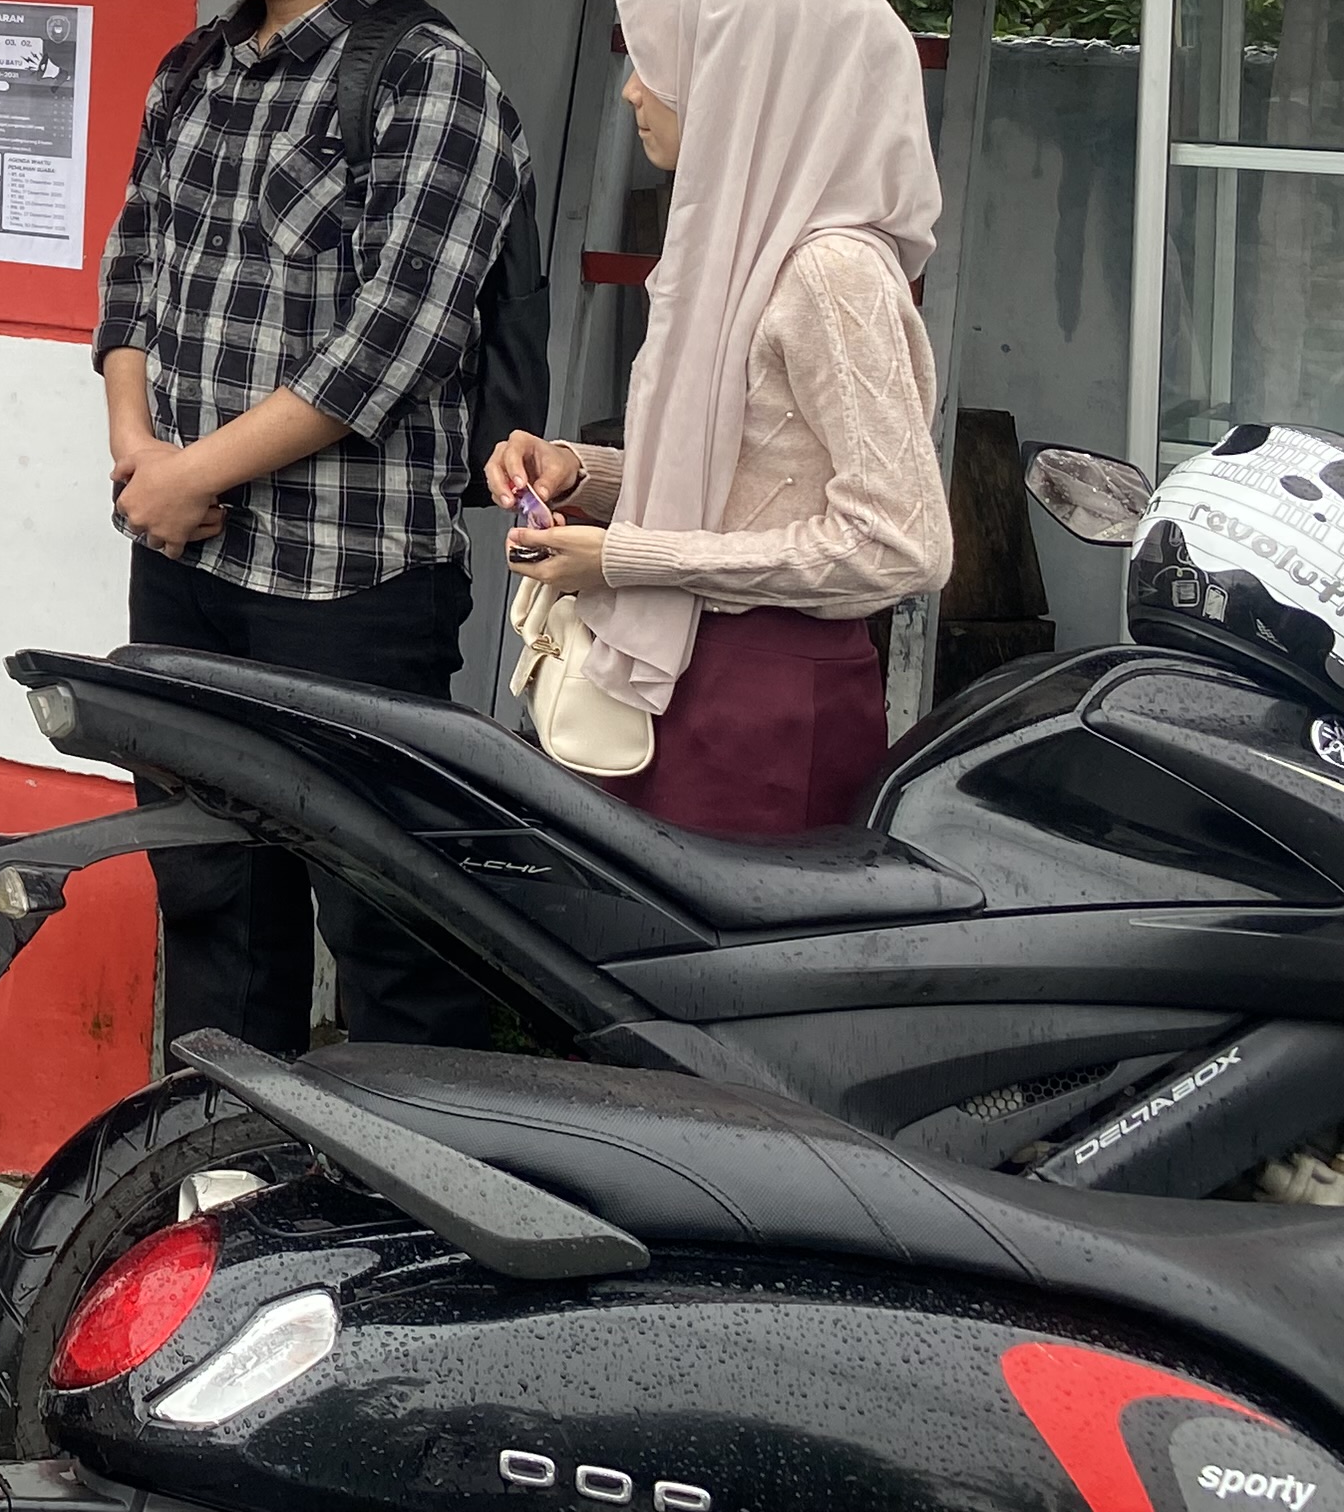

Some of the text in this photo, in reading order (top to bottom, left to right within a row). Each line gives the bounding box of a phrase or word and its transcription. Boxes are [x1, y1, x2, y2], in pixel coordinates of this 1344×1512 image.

[5, 59, 23, 67] BATU
[1074, 1046, 1243, 1166] DELTABOX
[1196, 1462, 1317, 1512] sporty
